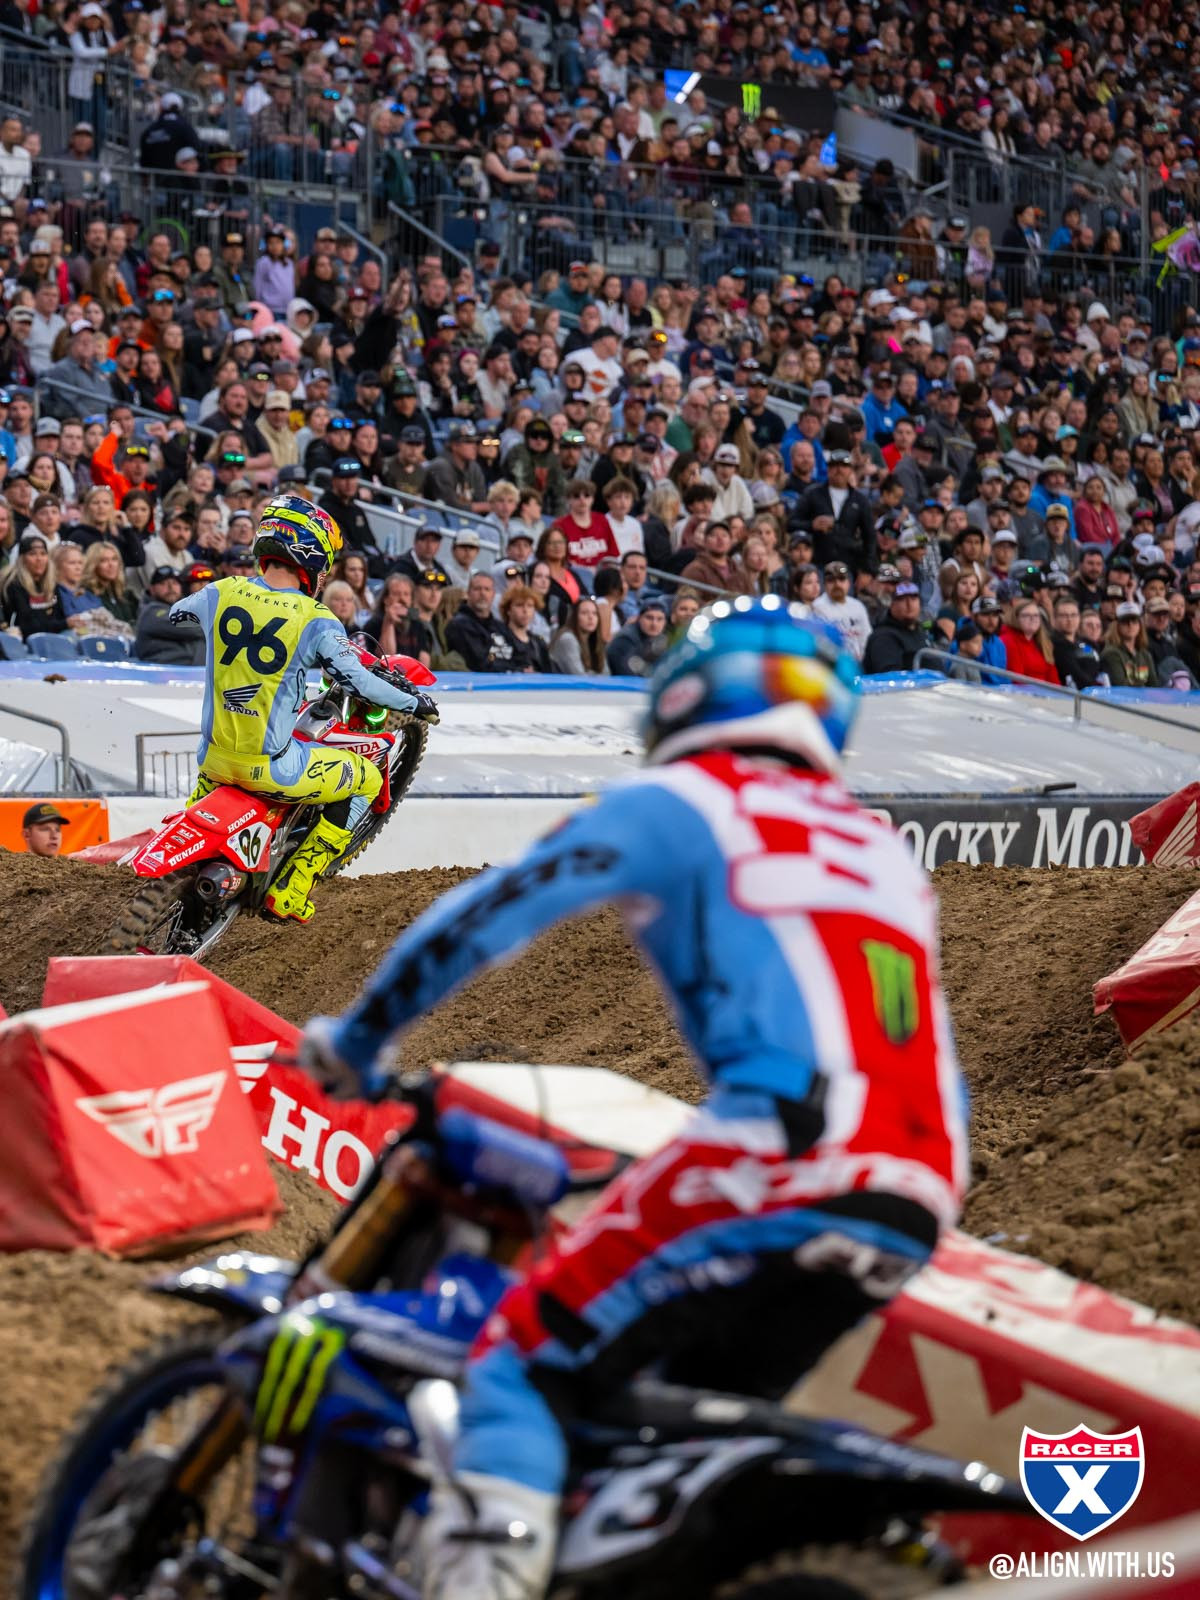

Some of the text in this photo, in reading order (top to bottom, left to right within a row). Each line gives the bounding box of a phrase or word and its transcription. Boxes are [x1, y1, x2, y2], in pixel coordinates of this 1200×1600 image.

[232, 589, 299, 610] AWRENCE
[218, 606, 288, 675] 96
[223, 703, 260, 717] HONDA
[227, 809, 257, 834] HONDA
[167, 839, 206, 867] DUNLOP
[238, 827, 262, 868] 96
